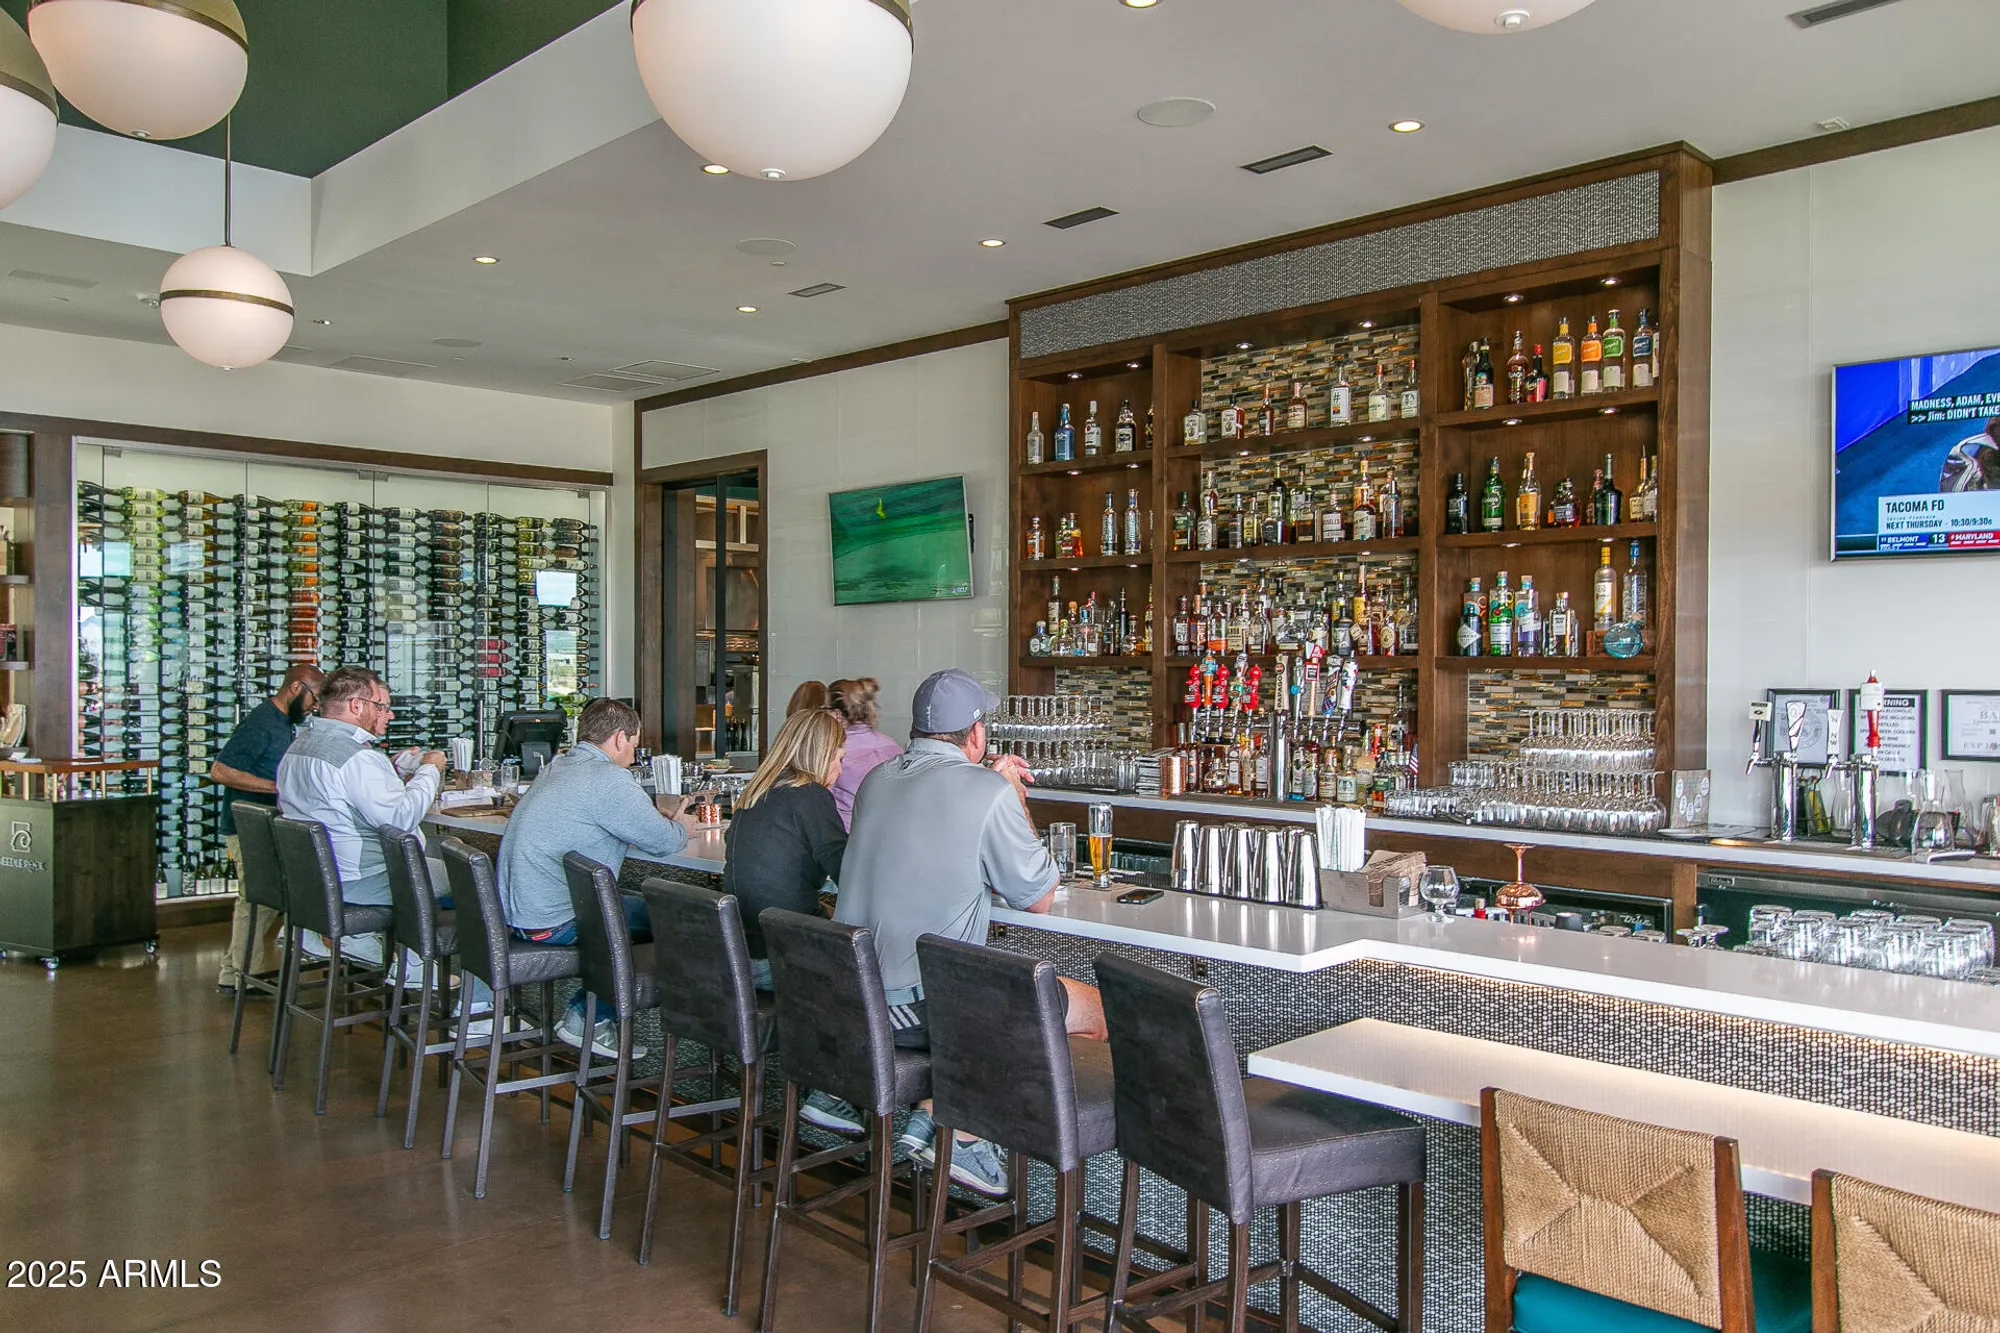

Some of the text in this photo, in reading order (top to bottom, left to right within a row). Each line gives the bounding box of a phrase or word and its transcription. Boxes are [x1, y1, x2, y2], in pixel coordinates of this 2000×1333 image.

[1911, 397, 1954, 411] MADNESS,
[1955, 394, 1984, 406] ADAM,
[1927, 411, 1946, 422] Jim:
[1946, 407, 1977, 420] DIDN'T
[1885, 499, 1945, 513] TACOMA FD
[1886, 521, 1906, 530] NEXT
[1906, 520, 1943, 529] THURSDAY
[1932, 534, 1946, 544] 13
